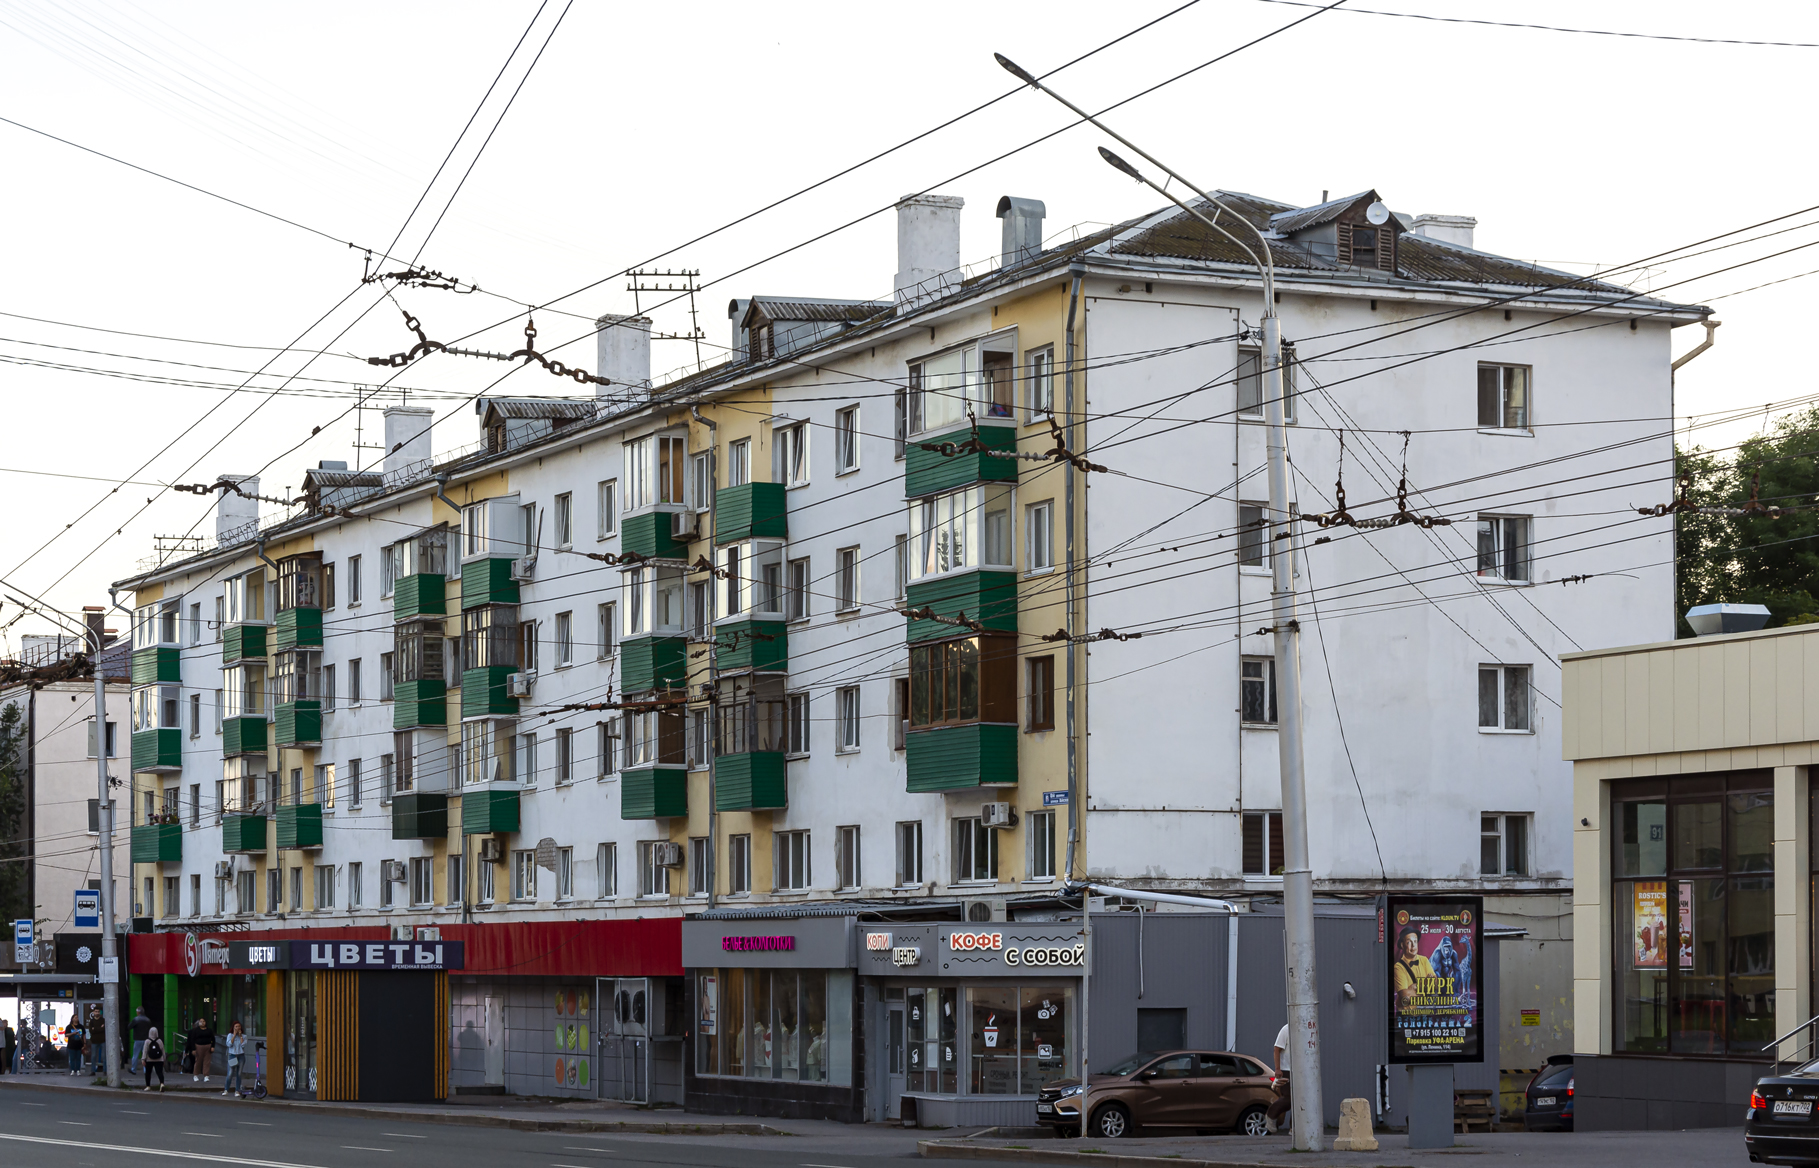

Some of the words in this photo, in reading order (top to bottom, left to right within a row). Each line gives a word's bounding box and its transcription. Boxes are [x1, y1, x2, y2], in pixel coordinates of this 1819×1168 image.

[1652, 827, 1662, 839] 91
[1420, 924, 1429, 934] 25
[1446, 924, 1454, 934] 30
[866, 933, 890, 950] КОПИ
[951, 933, 1002, 950] КОФЕ
[248, 946, 276, 965] ЦВЕТЫ
[310, 944, 443, 968] ЦВЕТЫ
[893, 947, 917, 966] ЦЕНТР
[1005, 948, 1019, 964] С
[1023, 944, 1084, 964] СОБОЙ
[1416, 977, 1455, 996] ЦИРК
[1410, 996, 1459, 1005] НИКУЛИНА
[1464, 1014, 1472, 1028] 2
